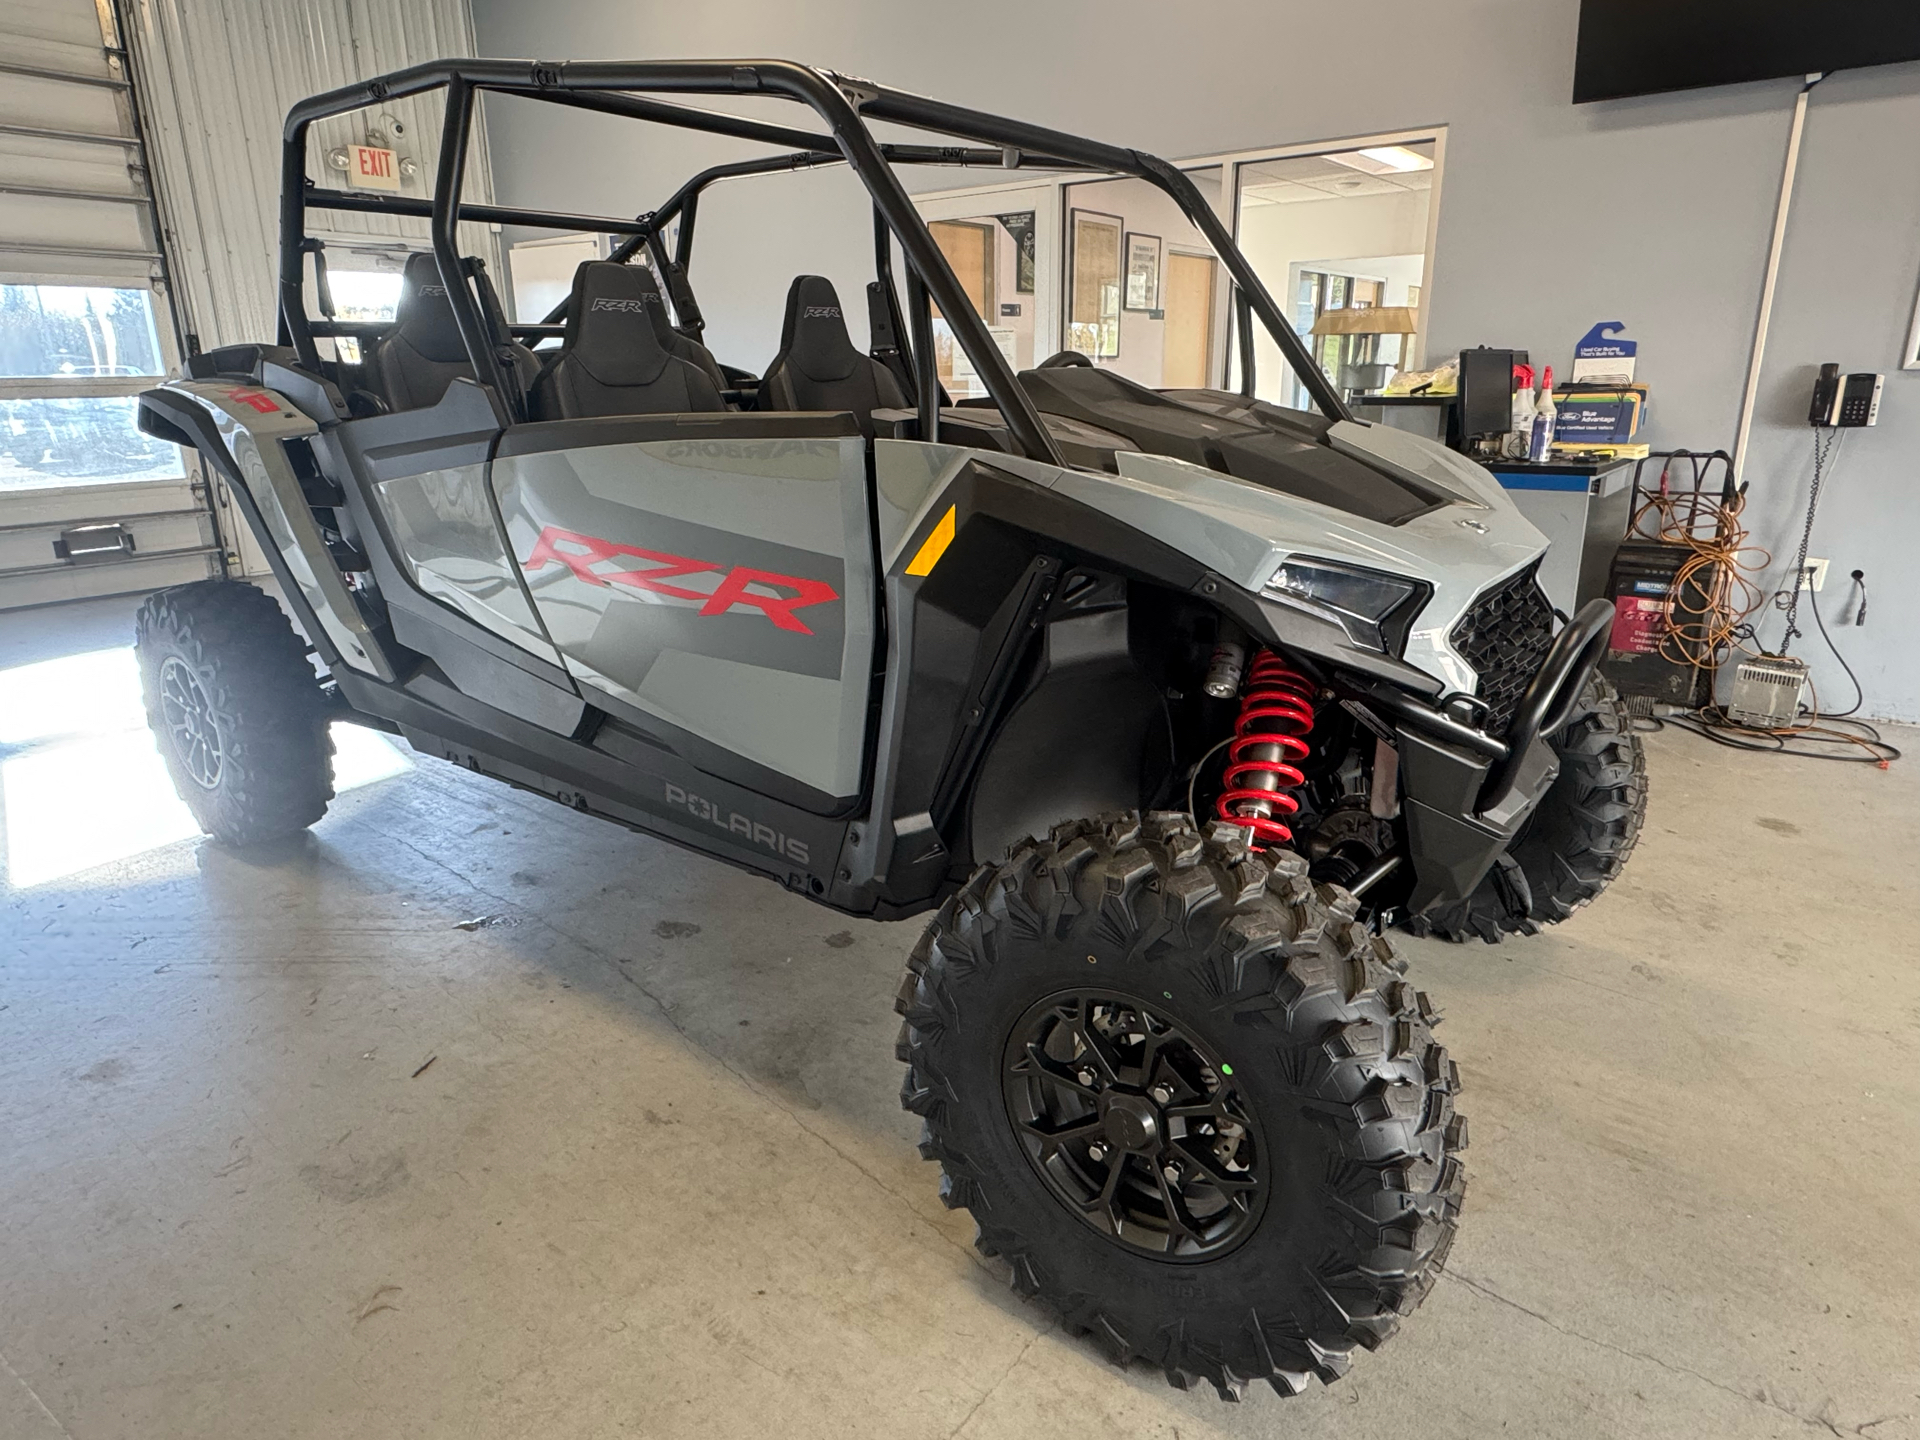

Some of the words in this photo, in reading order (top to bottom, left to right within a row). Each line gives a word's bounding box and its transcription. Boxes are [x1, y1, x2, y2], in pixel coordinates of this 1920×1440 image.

[358, 148, 391, 178] EXIT
[591, 298, 643, 313] RZR
[804, 306, 841, 318] RZR
[1560, 412, 1578, 420] Ford
[524, 526, 840, 636] RZR
[665, 782, 810, 865] POLARIS
